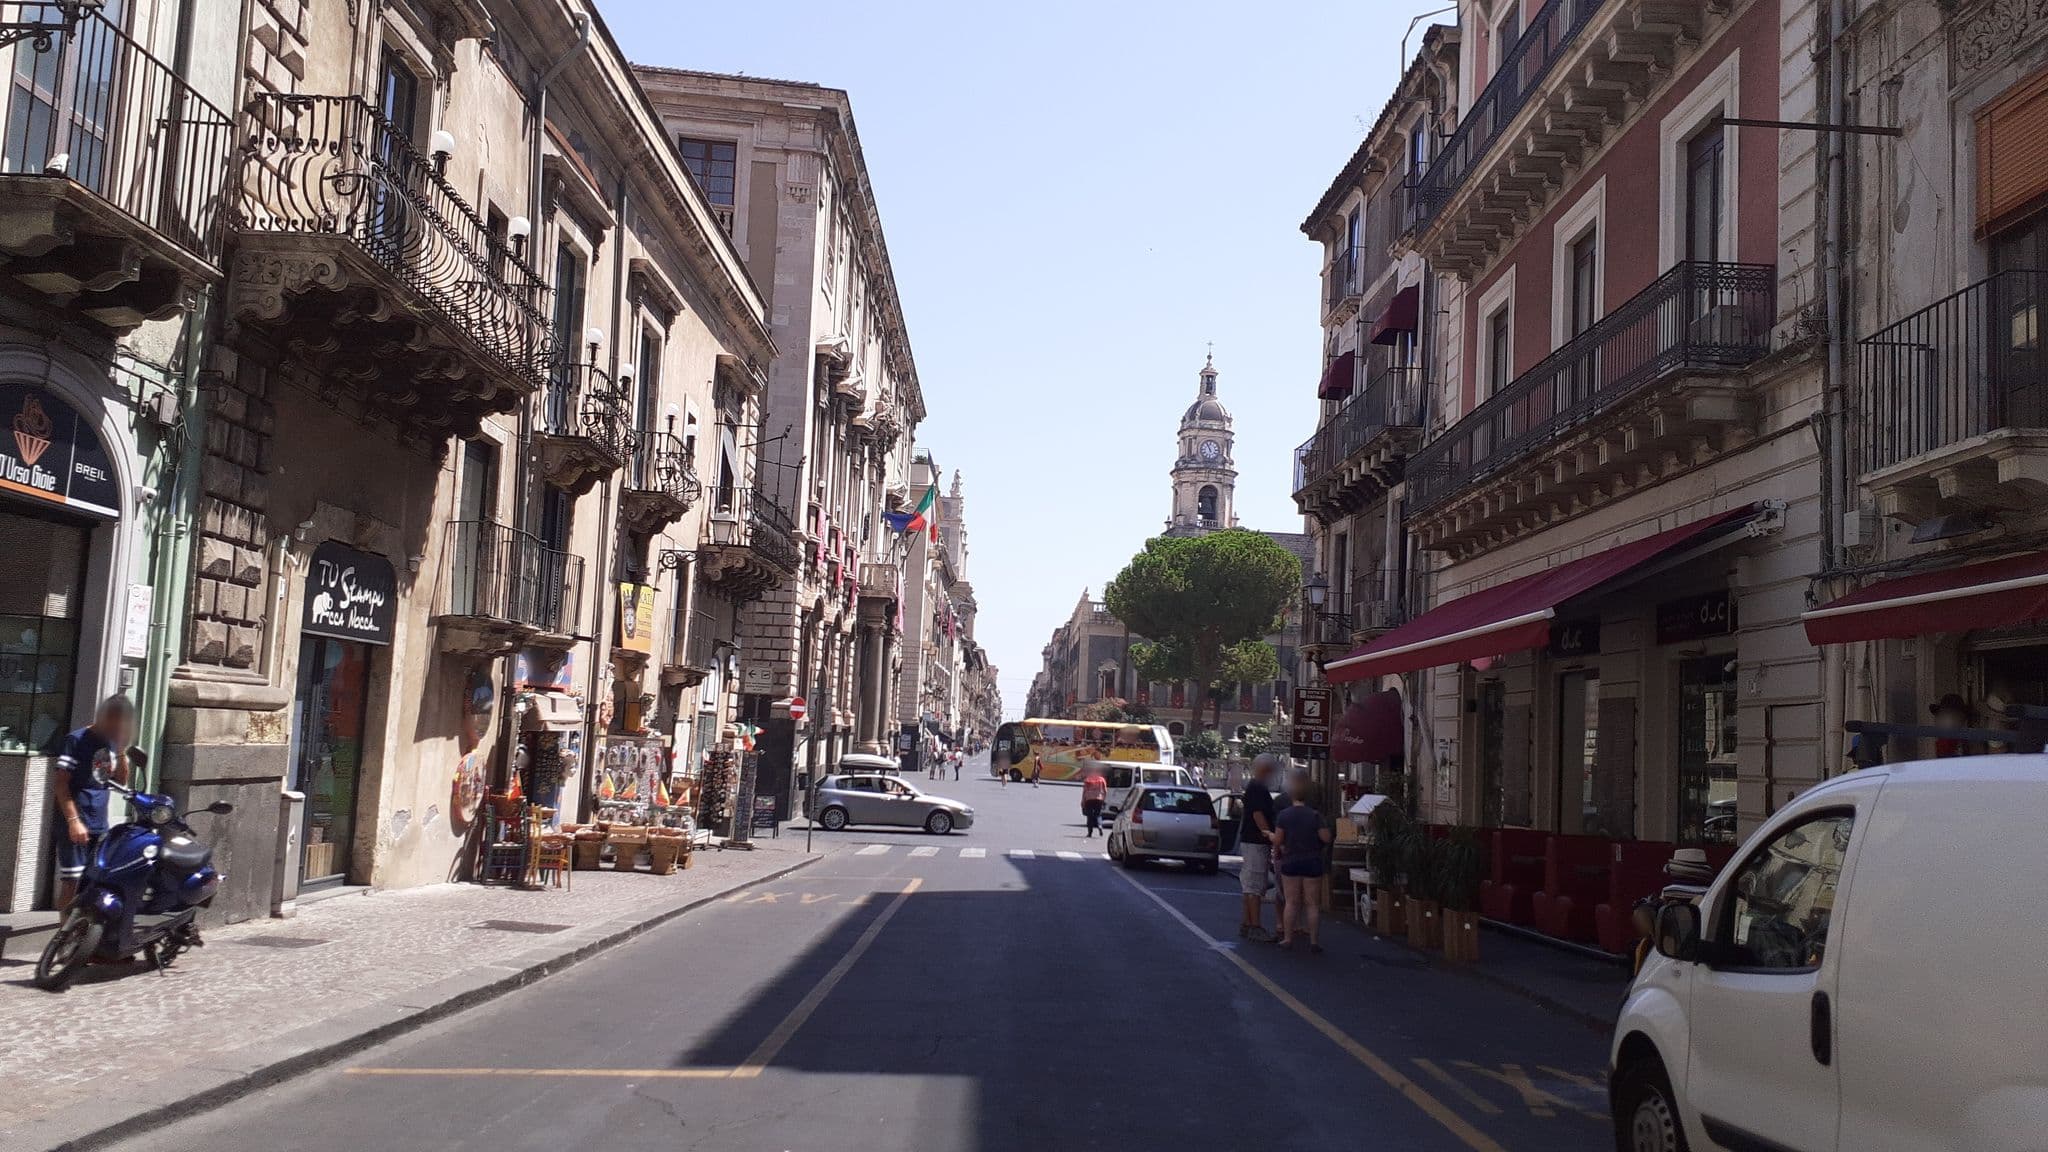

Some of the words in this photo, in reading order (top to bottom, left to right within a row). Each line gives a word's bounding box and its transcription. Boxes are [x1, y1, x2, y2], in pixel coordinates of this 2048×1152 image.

[31, 464, 56, 491] Gioie
[75, 462, 107, 481] BREIL
[319, 559, 339, 588] TU
